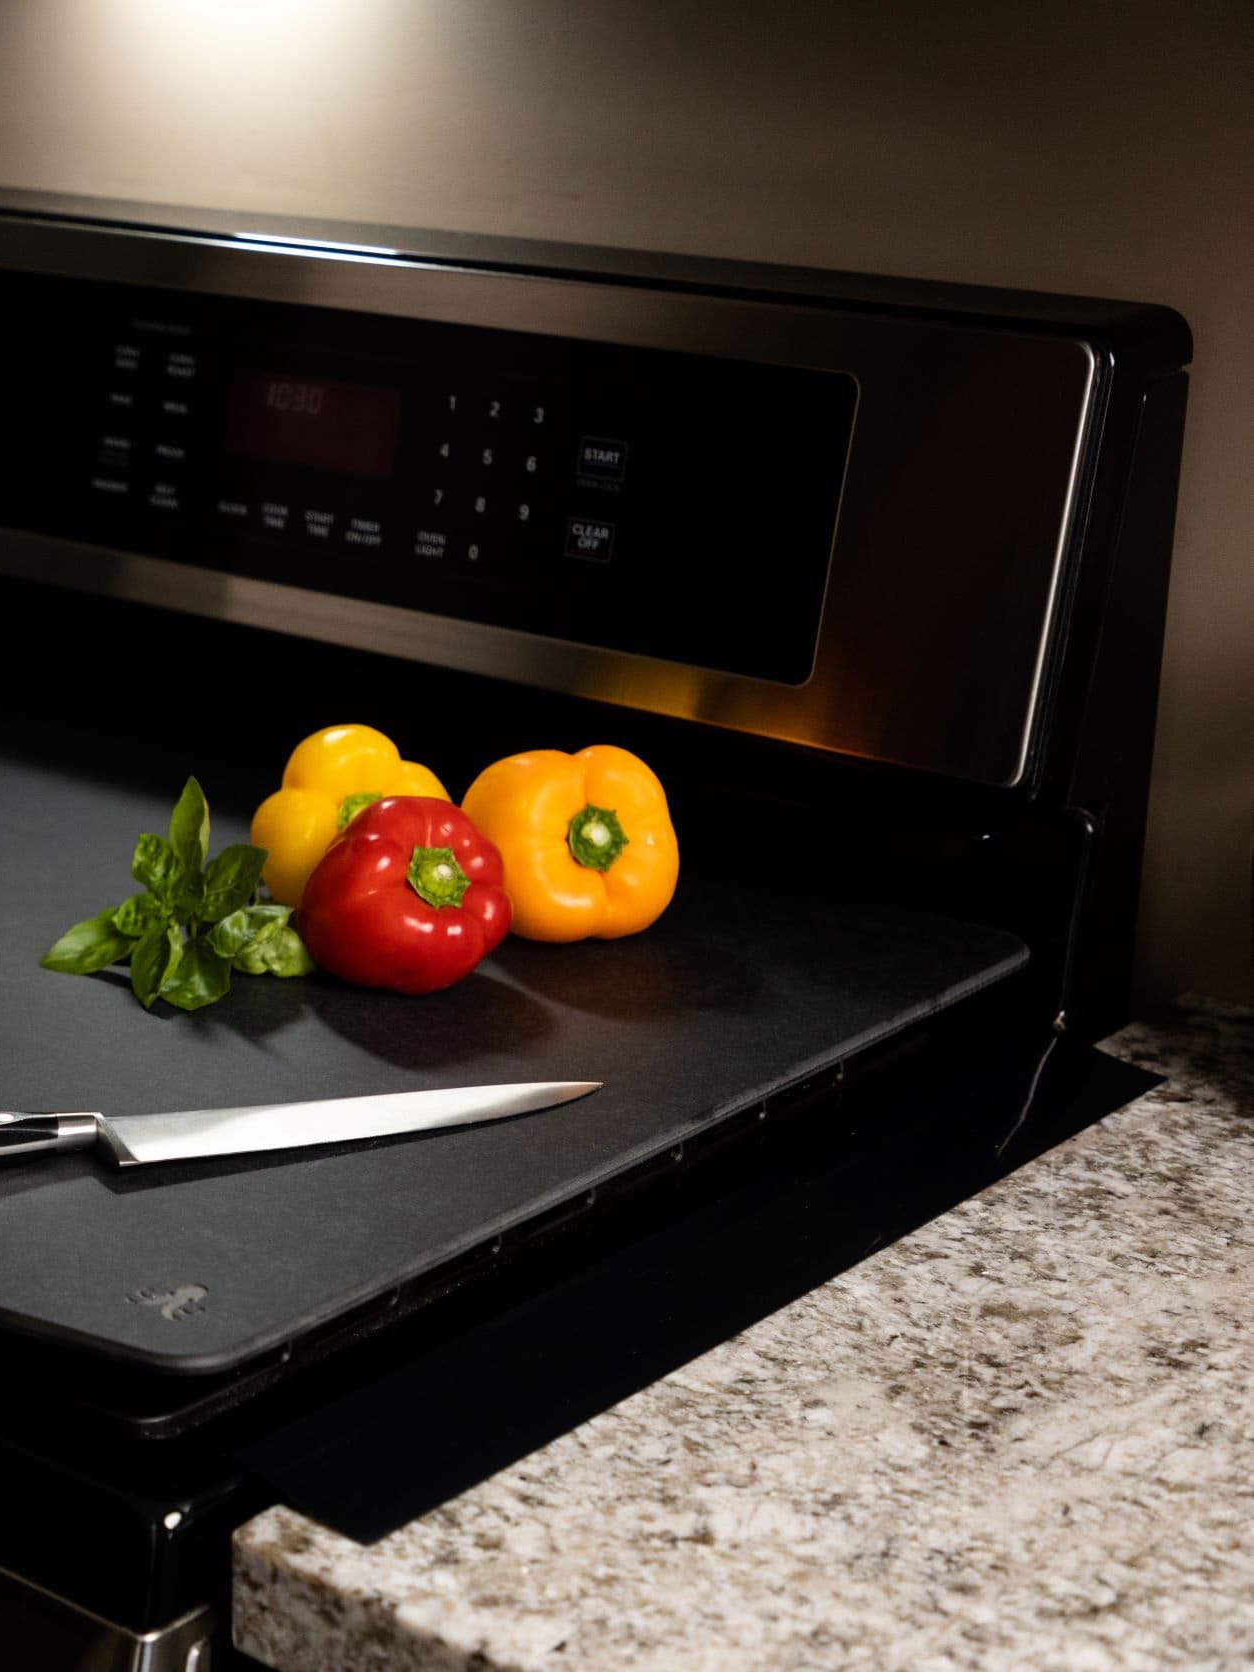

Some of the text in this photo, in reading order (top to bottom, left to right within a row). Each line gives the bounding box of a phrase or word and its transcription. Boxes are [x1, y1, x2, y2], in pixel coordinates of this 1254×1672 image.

[448, 394, 545, 424] 1 2 3
[439, 442, 537, 472] 4 5 6
[584, 447, 620, 465] START
[434, 488, 530, 521] 7 8 9
[572, 523, 610, 541] CLEAR
[468, 543, 479, 560] 0
[577, 537, 600, 551] OFF
